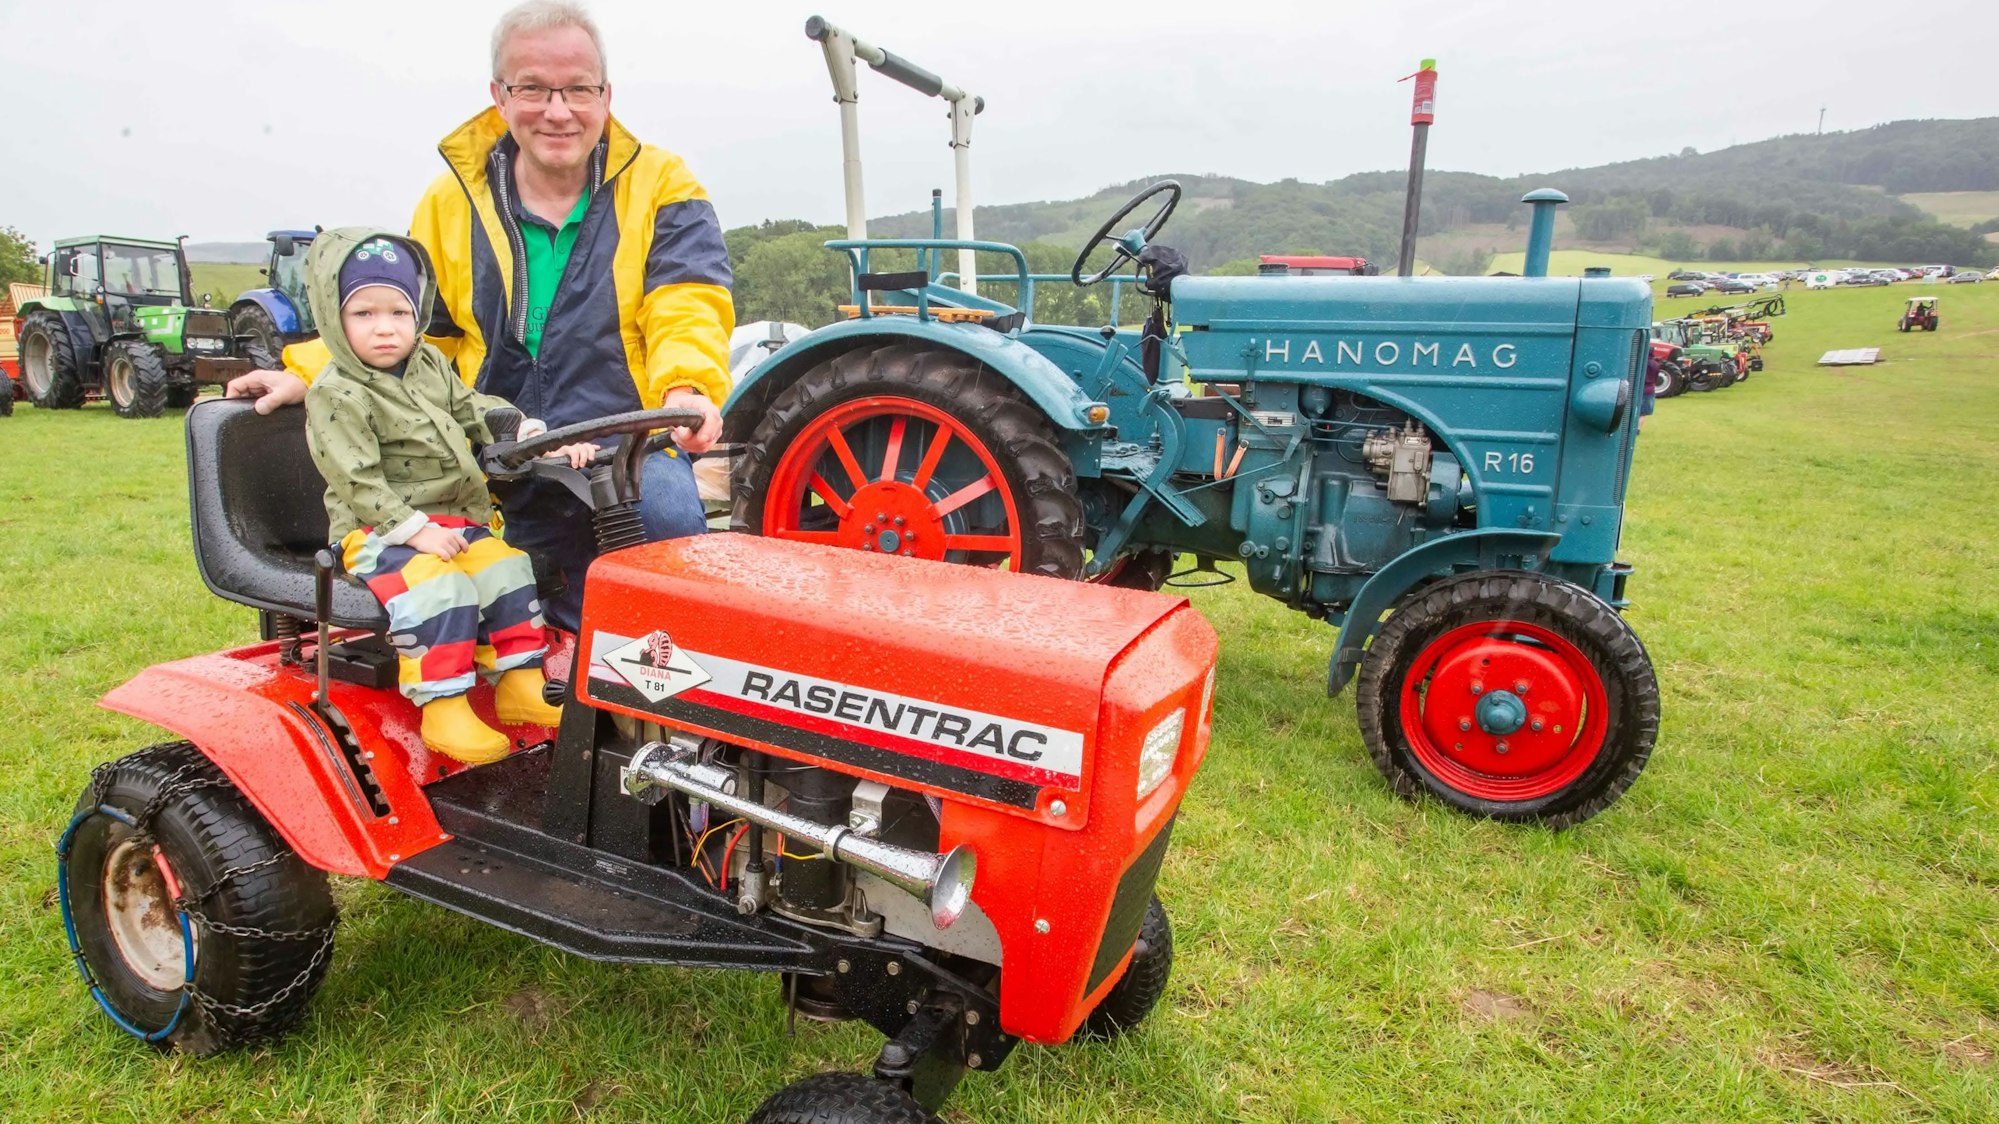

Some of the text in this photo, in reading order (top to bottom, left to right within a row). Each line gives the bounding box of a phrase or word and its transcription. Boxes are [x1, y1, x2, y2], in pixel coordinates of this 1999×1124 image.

[1265, 339, 1518, 369] HANOMAG
[640, 666, 672, 681] DIANA
[645, 680, 665, 692] T 81
[741, 670, 1048, 762] RASENTRAC
